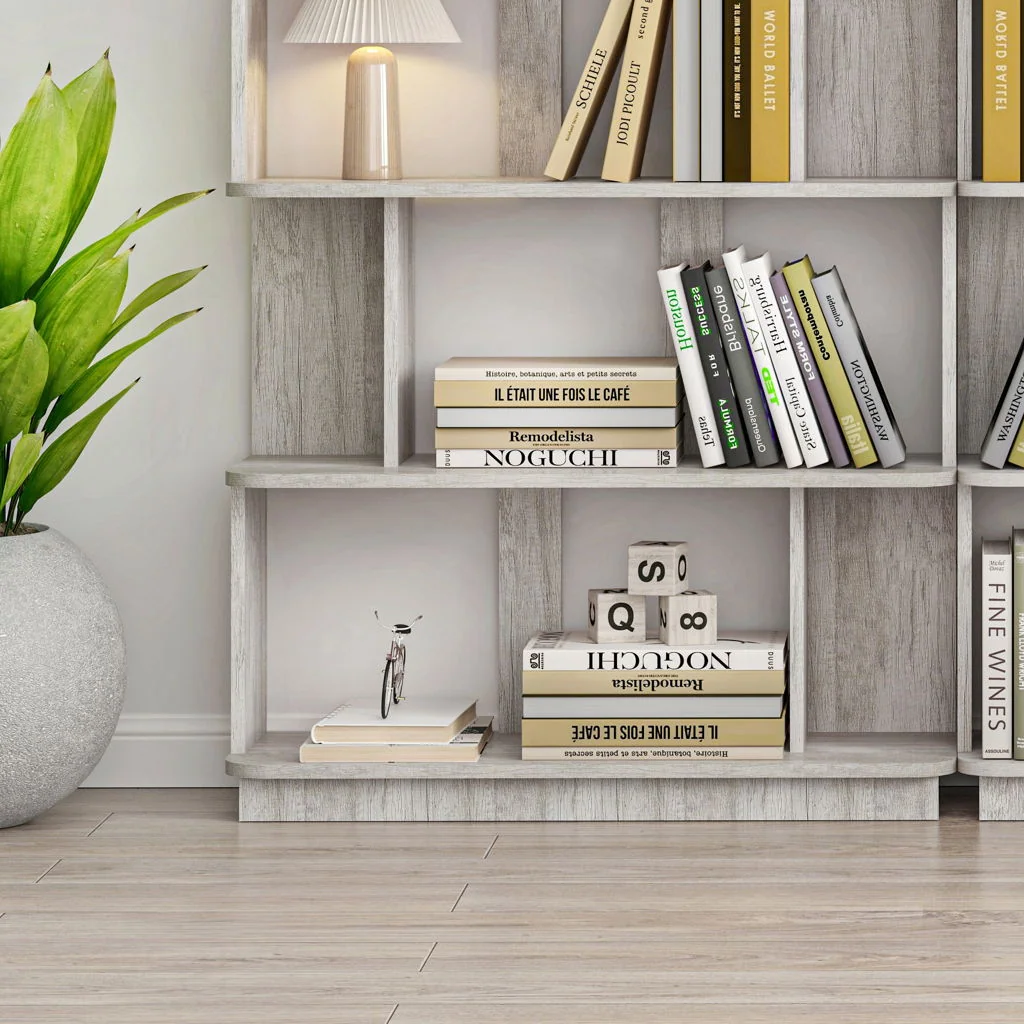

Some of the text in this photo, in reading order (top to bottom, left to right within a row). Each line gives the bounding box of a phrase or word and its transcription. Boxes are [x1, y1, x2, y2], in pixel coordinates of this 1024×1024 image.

[637, 4, 650, 39] second
[764, 10, 776, 111] WORLD BALLET
[575, 48, 607, 110] SCHIELE
[616, 60, 641, 146] JODI PICOULT
[520, 370, 558, 378] botanique,
[495, 385, 630, 401] IL ÉTAIT UNE FOIS LE CAFÉ
[509, 430, 594, 442] Remodelista
[484, 449, 618, 466] NOGUCHI
[607, 602, 635, 633] Q
[587, 651, 732, 670] NOGUCHI
[988, 584, 1006, 731] FINE WINES
[612, 679, 703, 692] Remodelista
[571, 725, 718, 742] IL ÉTAIT UNE FOIS LE CAFÉ
